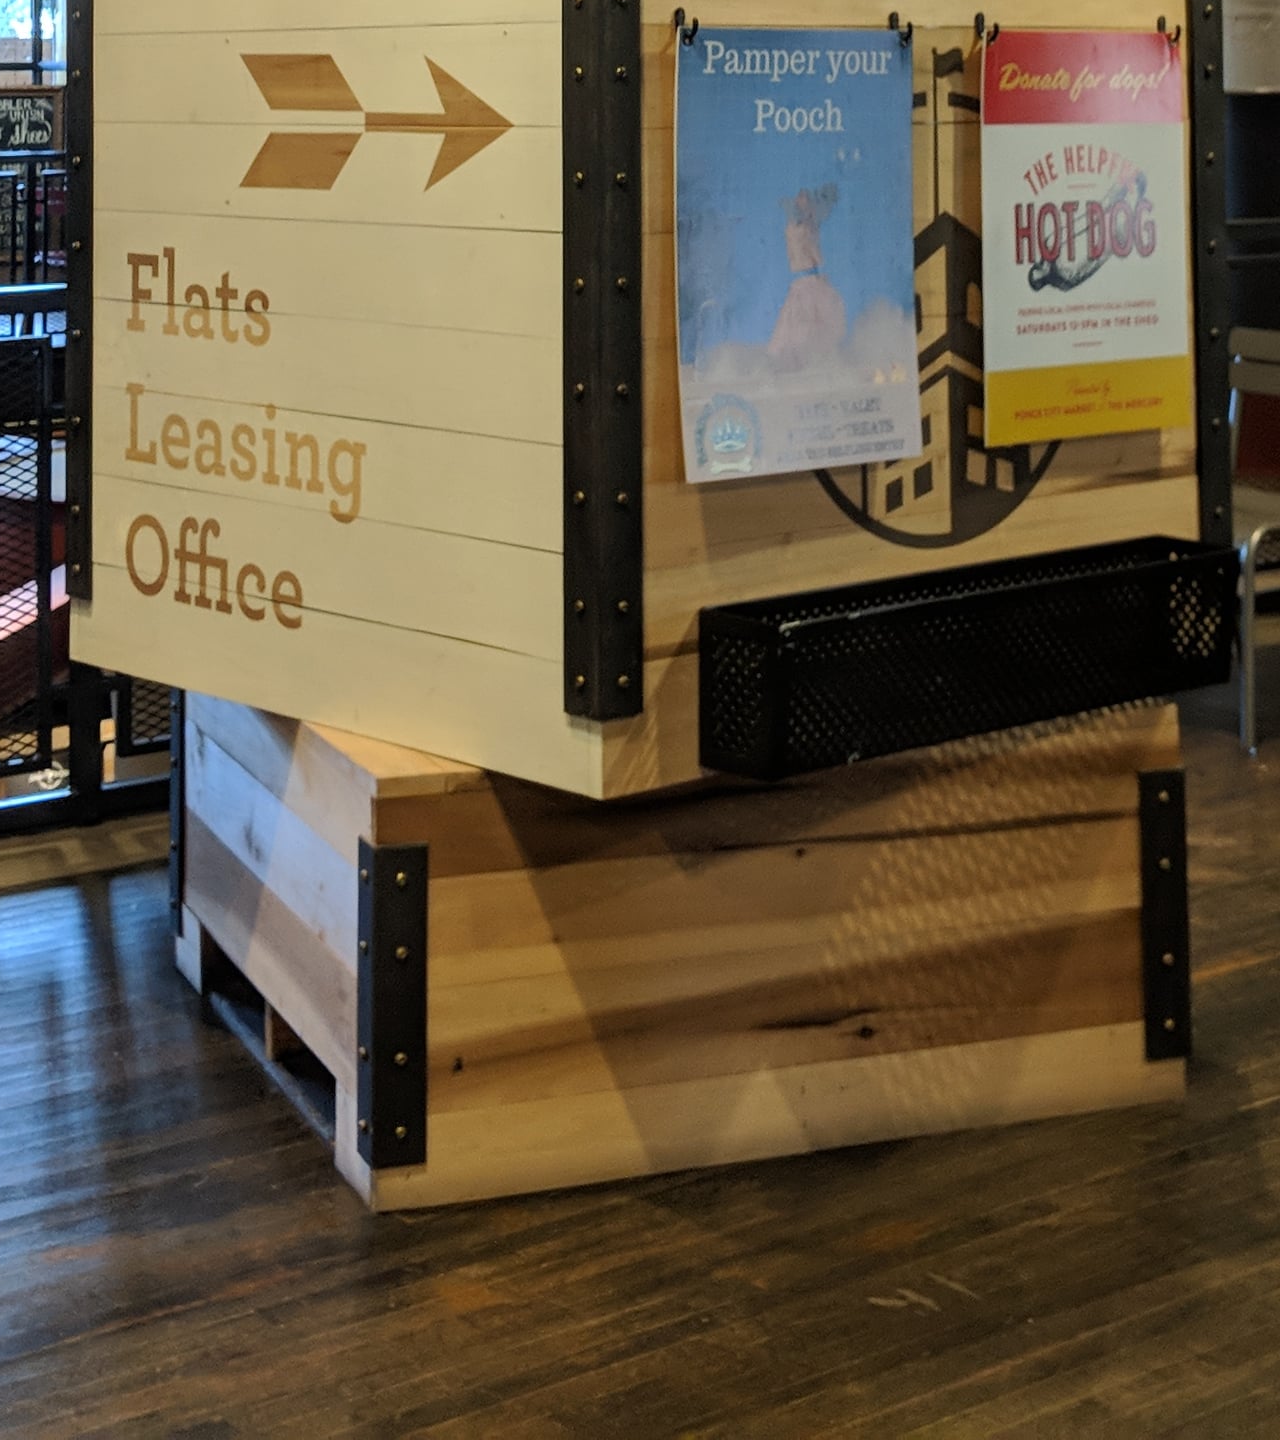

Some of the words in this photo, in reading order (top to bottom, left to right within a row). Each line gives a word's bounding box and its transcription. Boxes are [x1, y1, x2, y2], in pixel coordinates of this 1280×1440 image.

[702, 39, 821, 83] Pamper
[825, 48, 893, 84] your
[998, 62, 1070, 91] Donate
[1070, 63, 1106, 103] for
[1109, 62, 1169, 101] dogs!
[752, 98, 846, 133] Pooch
[1023, 151, 1060, 197] THE
[1013, 200, 1081, 266] HOT
[1085, 198, 1157, 262] DOG
[126, 246, 272, 347] Flats
[124, 382, 367, 524] Leasing
[125, 513, 304, 630] Office
